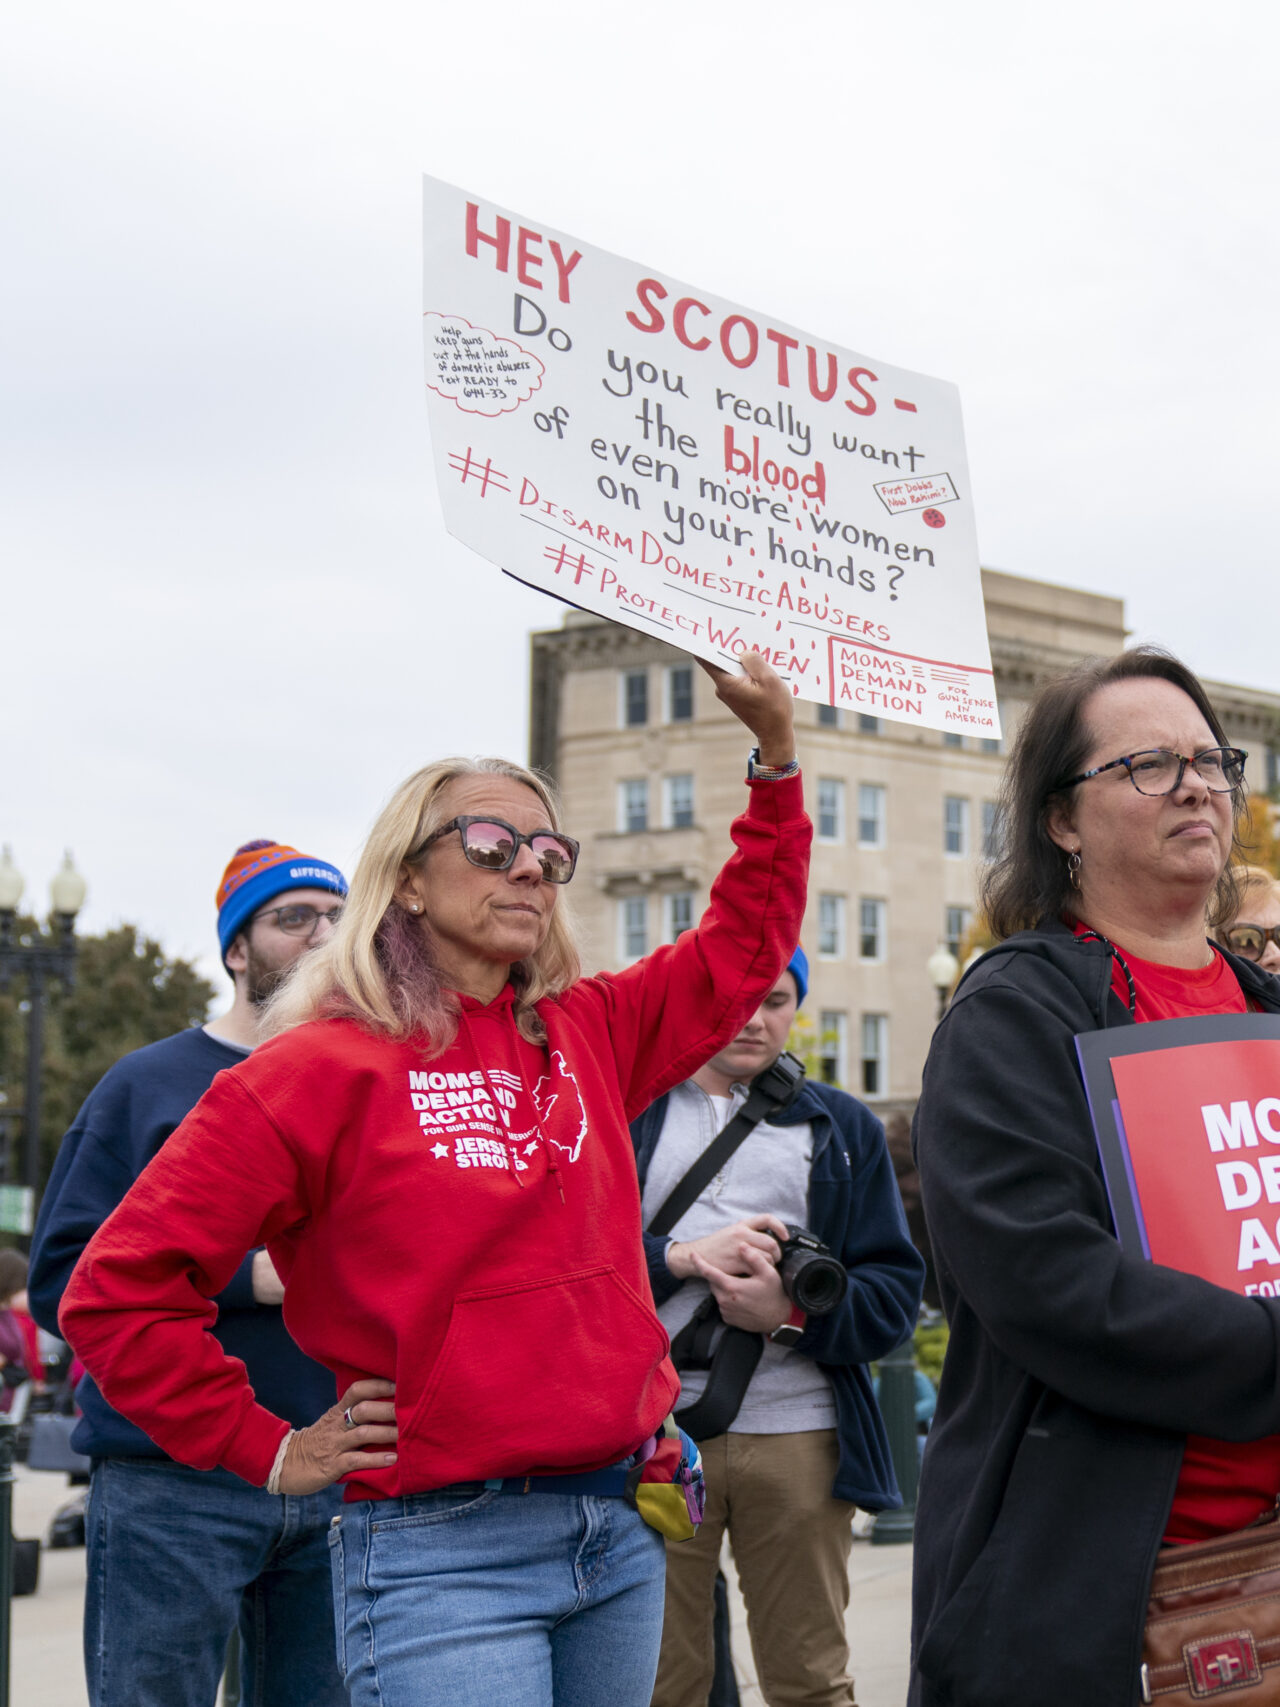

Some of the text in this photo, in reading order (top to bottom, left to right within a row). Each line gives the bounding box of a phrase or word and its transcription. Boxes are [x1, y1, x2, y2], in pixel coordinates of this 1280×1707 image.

[466, 201, 582, 303] HEY
[441, 326, 462, 339] Help
[482, 346, 509, 360] hands
[451, 362, 493, 373] domestic
[496, 361, 531, 372] abusers
[438, 374, 518, 386] Text READY to
[514, 293, 925, 472] Do you really want
[463, 387, 508, 399] 644-33
[636, 397, 827, 505] the blood
[534, 406, 935, 568] of even more women
[598, 473, 905, 602] on your hands?
[840, 648, 905, 676] MOMS
[840, 663, 927, 694] DEMAND
[840, 682, 922, 715] ACTION
[938, 692, 995, 709] GUN SENSE
[947, 686, 969, 696] FOR
[945, 710, 993, 727] AMERICA
[957, 704, 970, 713] IN
[408, 1070, 485, 1091] MOMS
[410, 1086, 517, 1110] DEMAND
[419, 1103, 510, 1127] ACTION
[422, 1126, 444, 1136] FOR
[446, 1124, 467, 1133] GUN
[469, 1121, 496, 1134] SENSE
